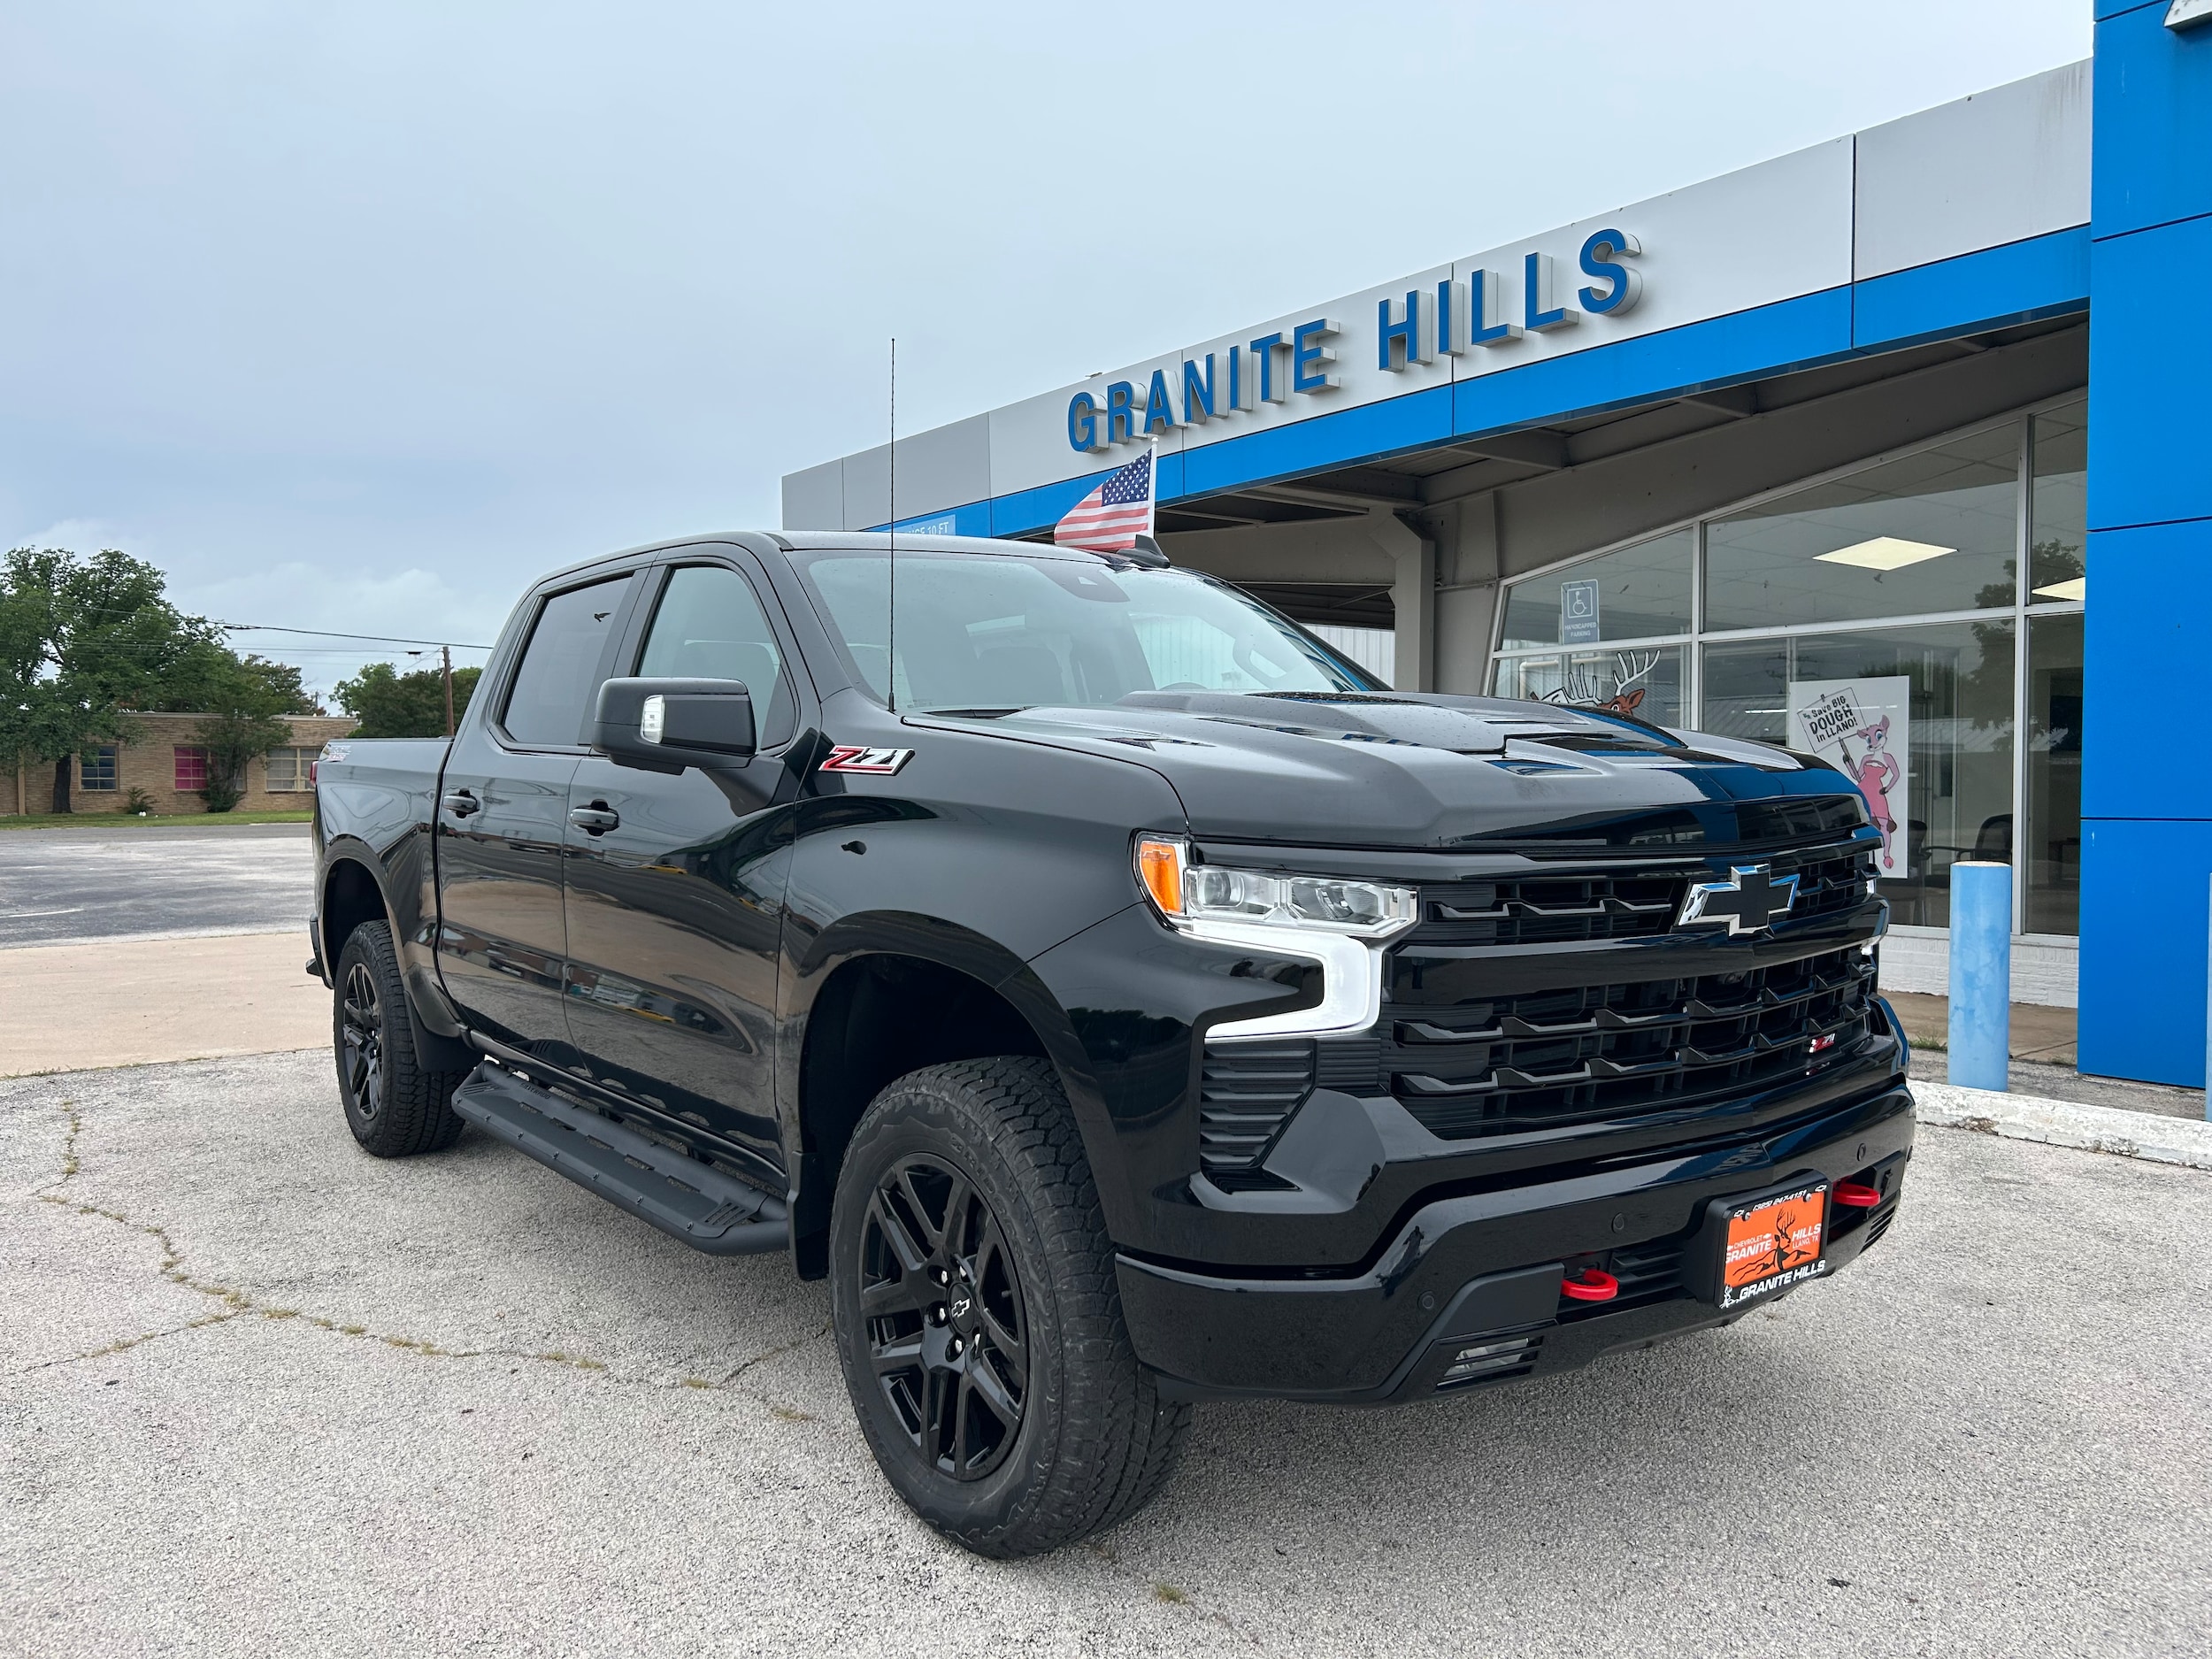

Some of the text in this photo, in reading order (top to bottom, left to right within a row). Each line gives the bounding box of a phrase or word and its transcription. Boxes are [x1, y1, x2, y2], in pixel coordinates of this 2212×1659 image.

[1068, 227, 1637, 454] GRANITE HILLS
[939, 521, 949, 535] FT
[1564, 621, 1597, 631] HANDICAPPED
[1832, 695, 1846, 708] BIG
[1809, 703, 1854, 735] DOUGH
[1825, 717, 1858, 738] LLANO!
[818, 745, 915, 776] Z71
[1734, 1234, 1763, 1249] CHEVROLET
[1792, 1223, 1822, 1242] HILLS
[1739, 1259, 1826, 1301] GRANITE HILLS
